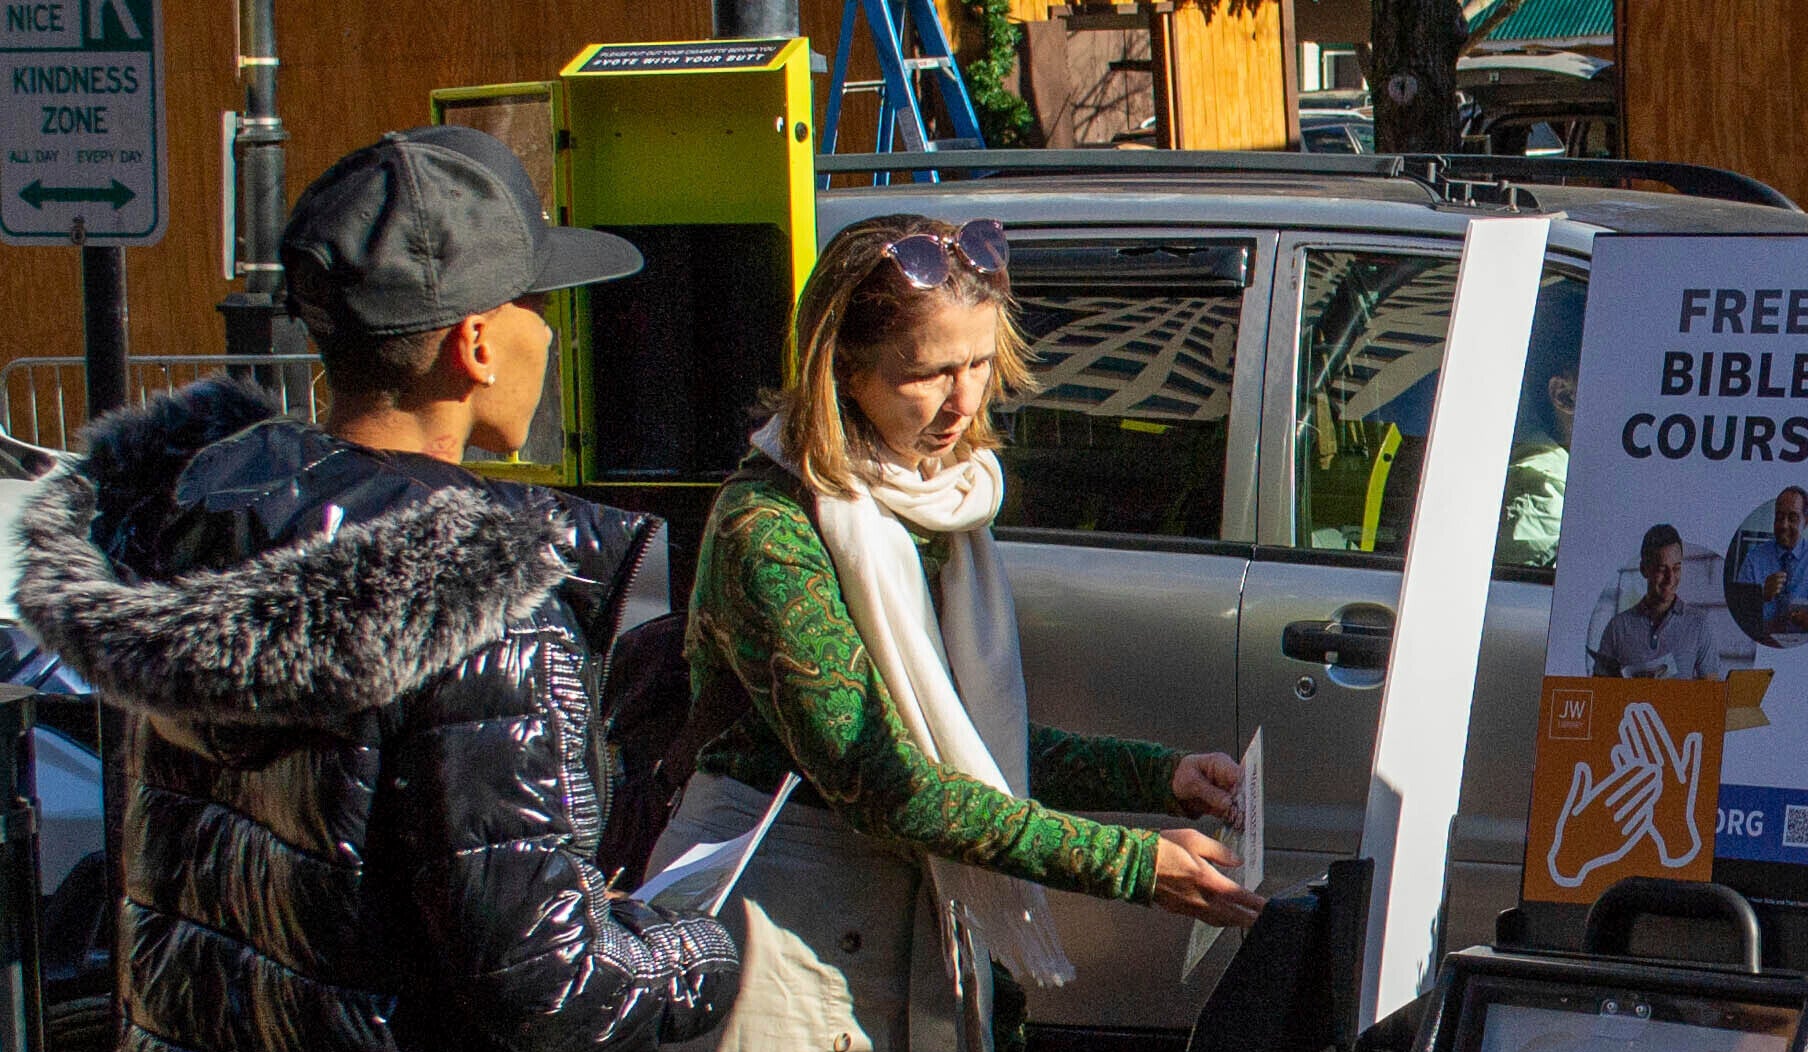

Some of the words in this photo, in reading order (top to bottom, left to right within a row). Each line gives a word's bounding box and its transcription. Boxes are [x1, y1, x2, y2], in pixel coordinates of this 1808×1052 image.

[8, 4, 65, 32] NICE
[642, 56, 680, 64] WITH
[684, 55, 722, 63] YOUR
[726, 53, 765, 62] BUTT
[13, 65, 139, 94] KINDNESS
[41, 105, 109, 134] ZONE
[8, 150, 31, 163] ALL
[35, 150, 60, 162] DAY
[77, 150, 115, 163] EVERY
[120, 150, 144, 163] DAY
[1559, 700, 1586, 720] JW
